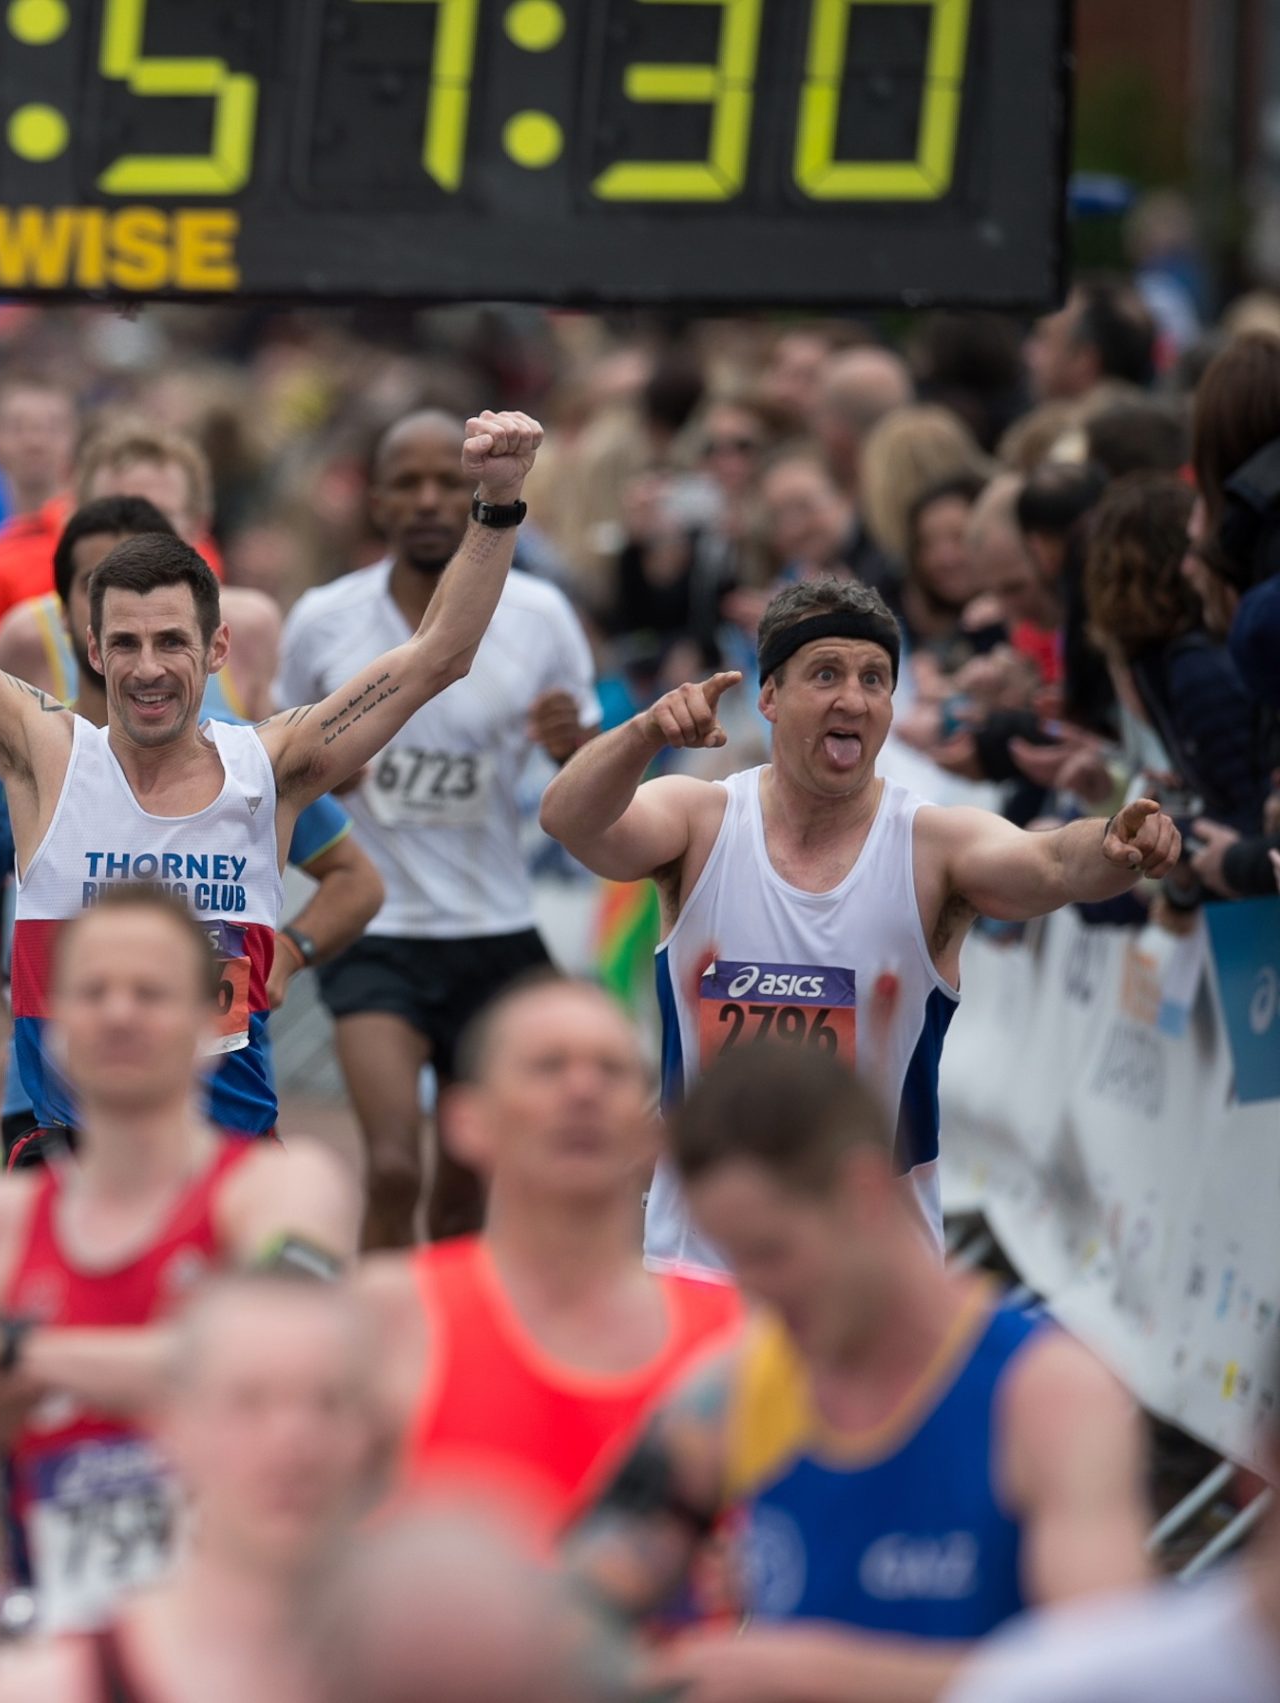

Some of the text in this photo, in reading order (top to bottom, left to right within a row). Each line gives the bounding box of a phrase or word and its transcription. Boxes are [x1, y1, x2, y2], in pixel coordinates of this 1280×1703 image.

[376, 746, 479, 801] 6723
[85, 852, 247, 881] THORNEY
[194, 883, 246, 912] CLUB
[719, 1003, 837, 1060] 2796
